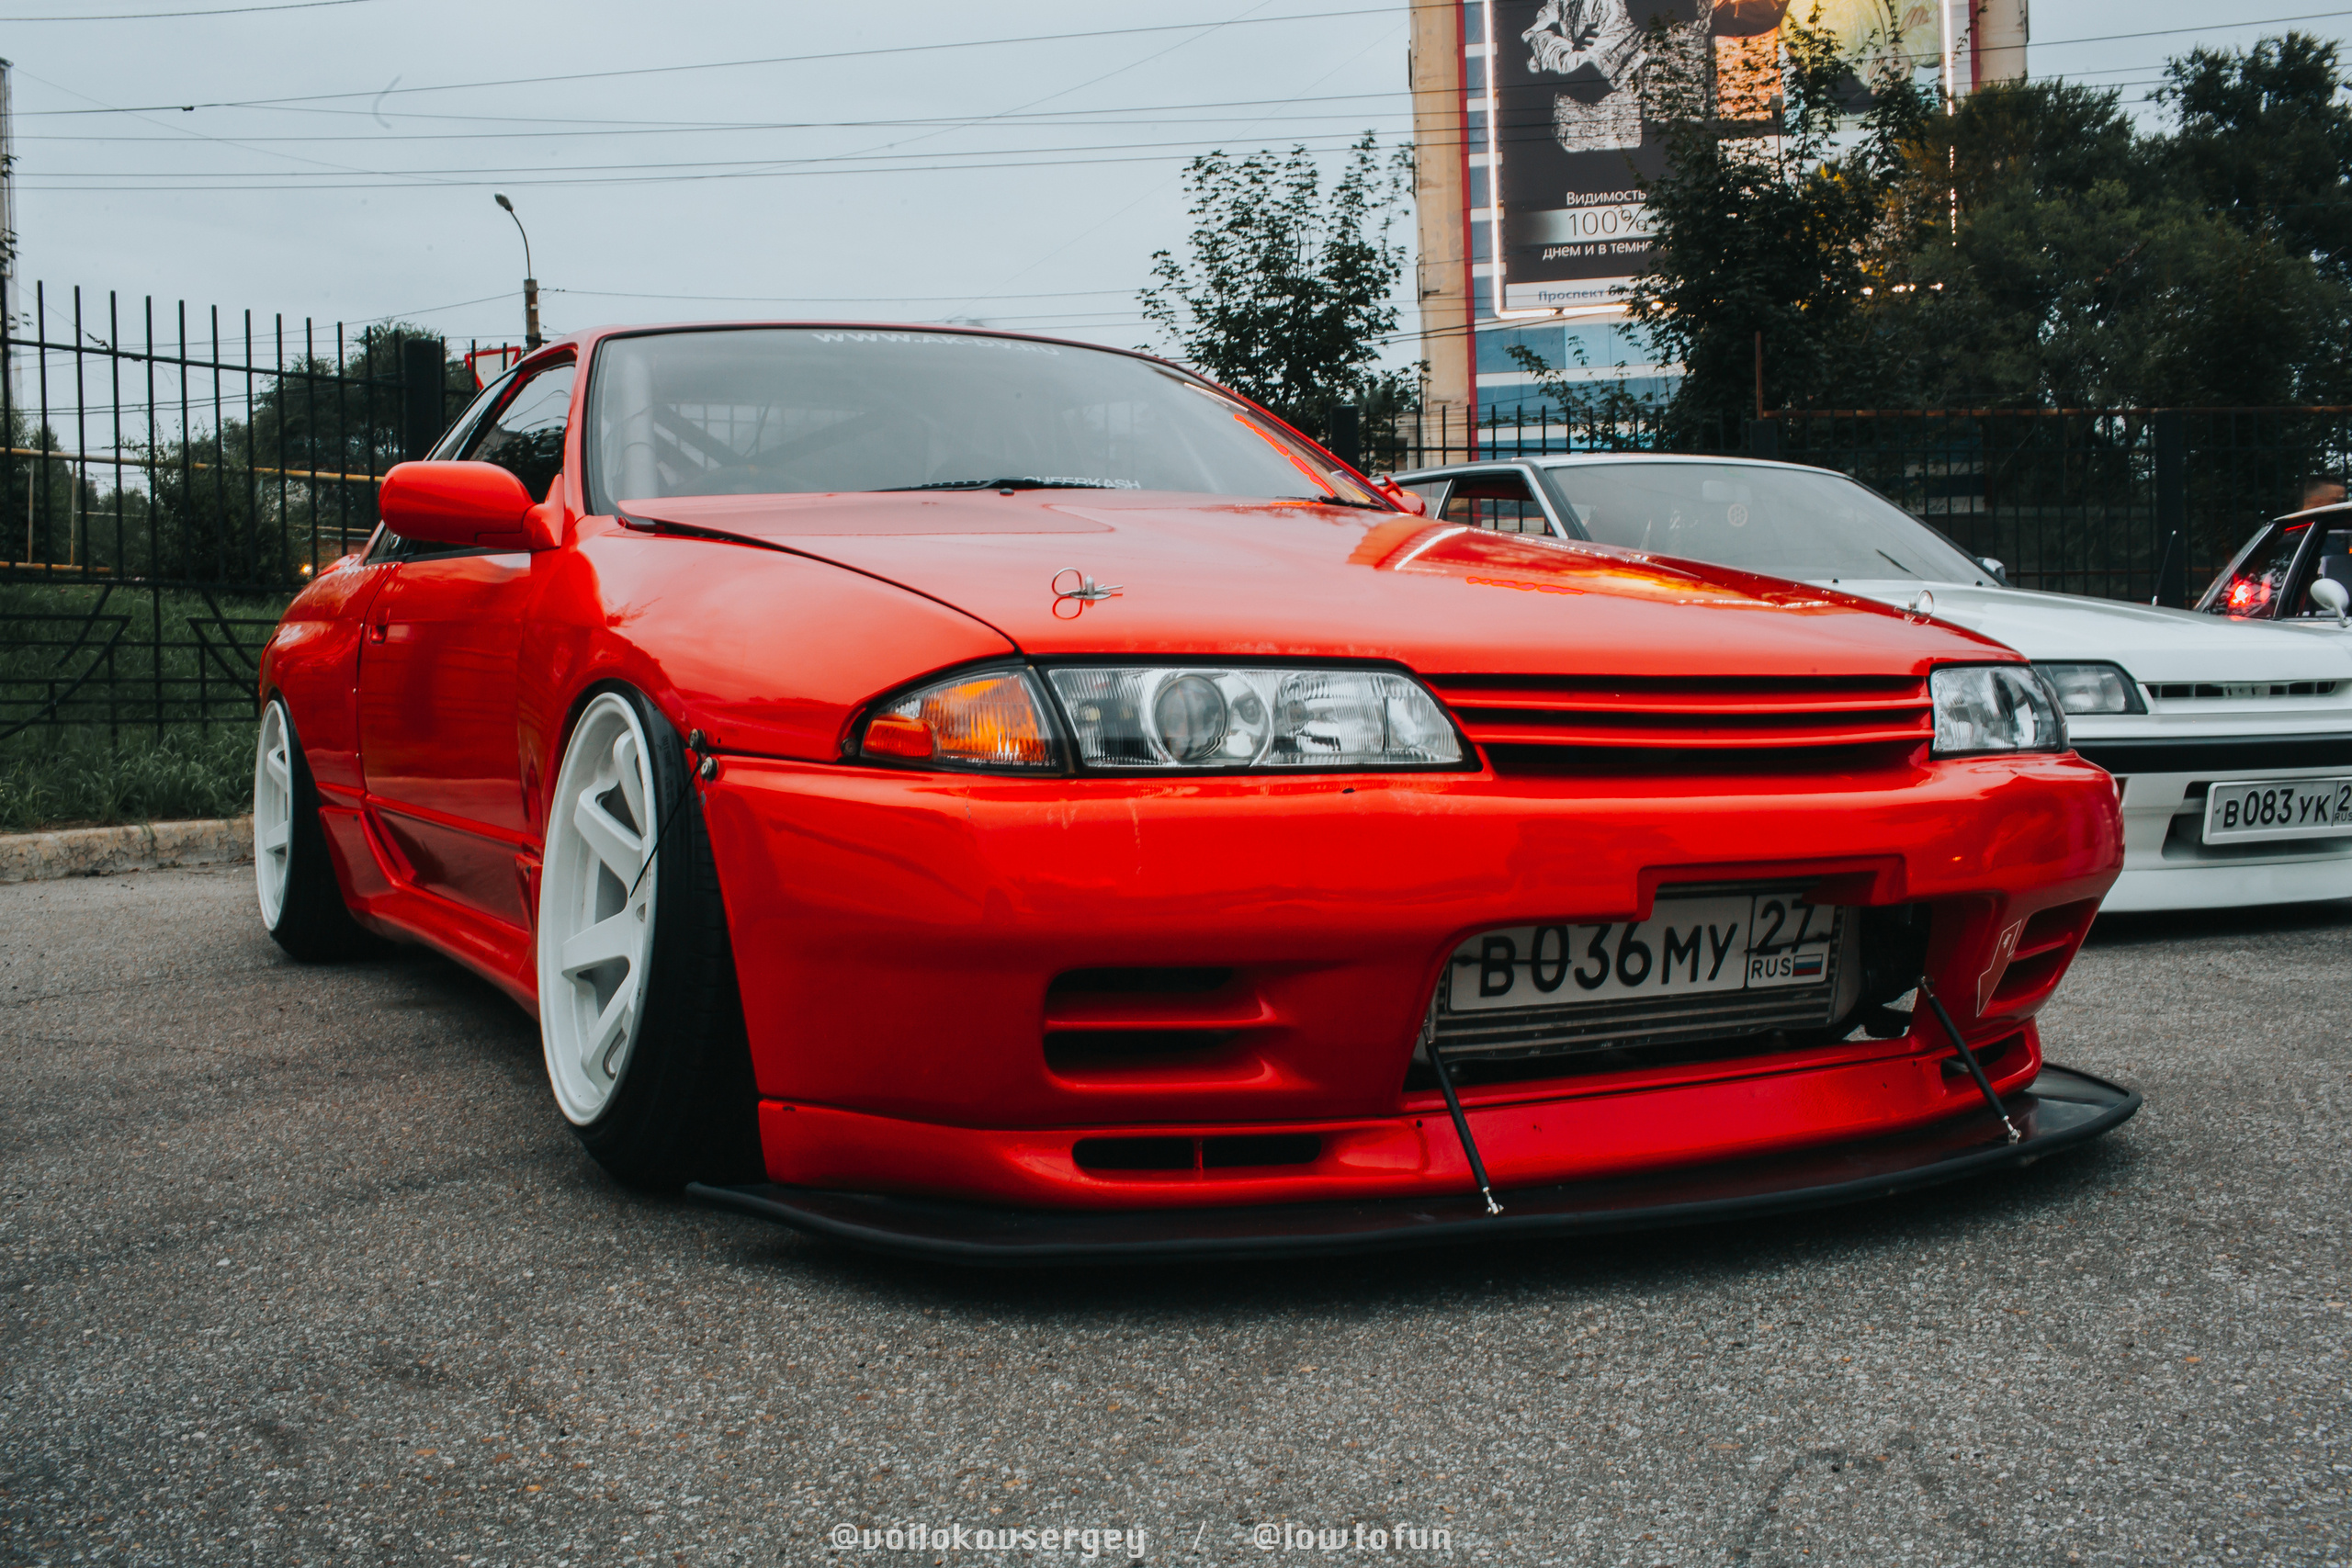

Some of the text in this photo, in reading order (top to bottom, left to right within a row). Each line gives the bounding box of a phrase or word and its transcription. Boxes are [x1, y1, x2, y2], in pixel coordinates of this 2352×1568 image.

[1566, 189, 1646, 206] Видимость
[1568, 205, 1647, 236] 100%
[1543, 245, 1580, 261] днем
[1585, 244, 1594, 255] и
[1599, 243, 1607, 255] в
[1538, 288, 1605, 302] Проспект
[812, 333, 1060, 355] WWW.AK-DV.RU
[2223, 788, 2331, 828] В083УК
[1479, 899, 1817, 997] В036МУ 27
[1750, 956, 1792, 979] RUS
